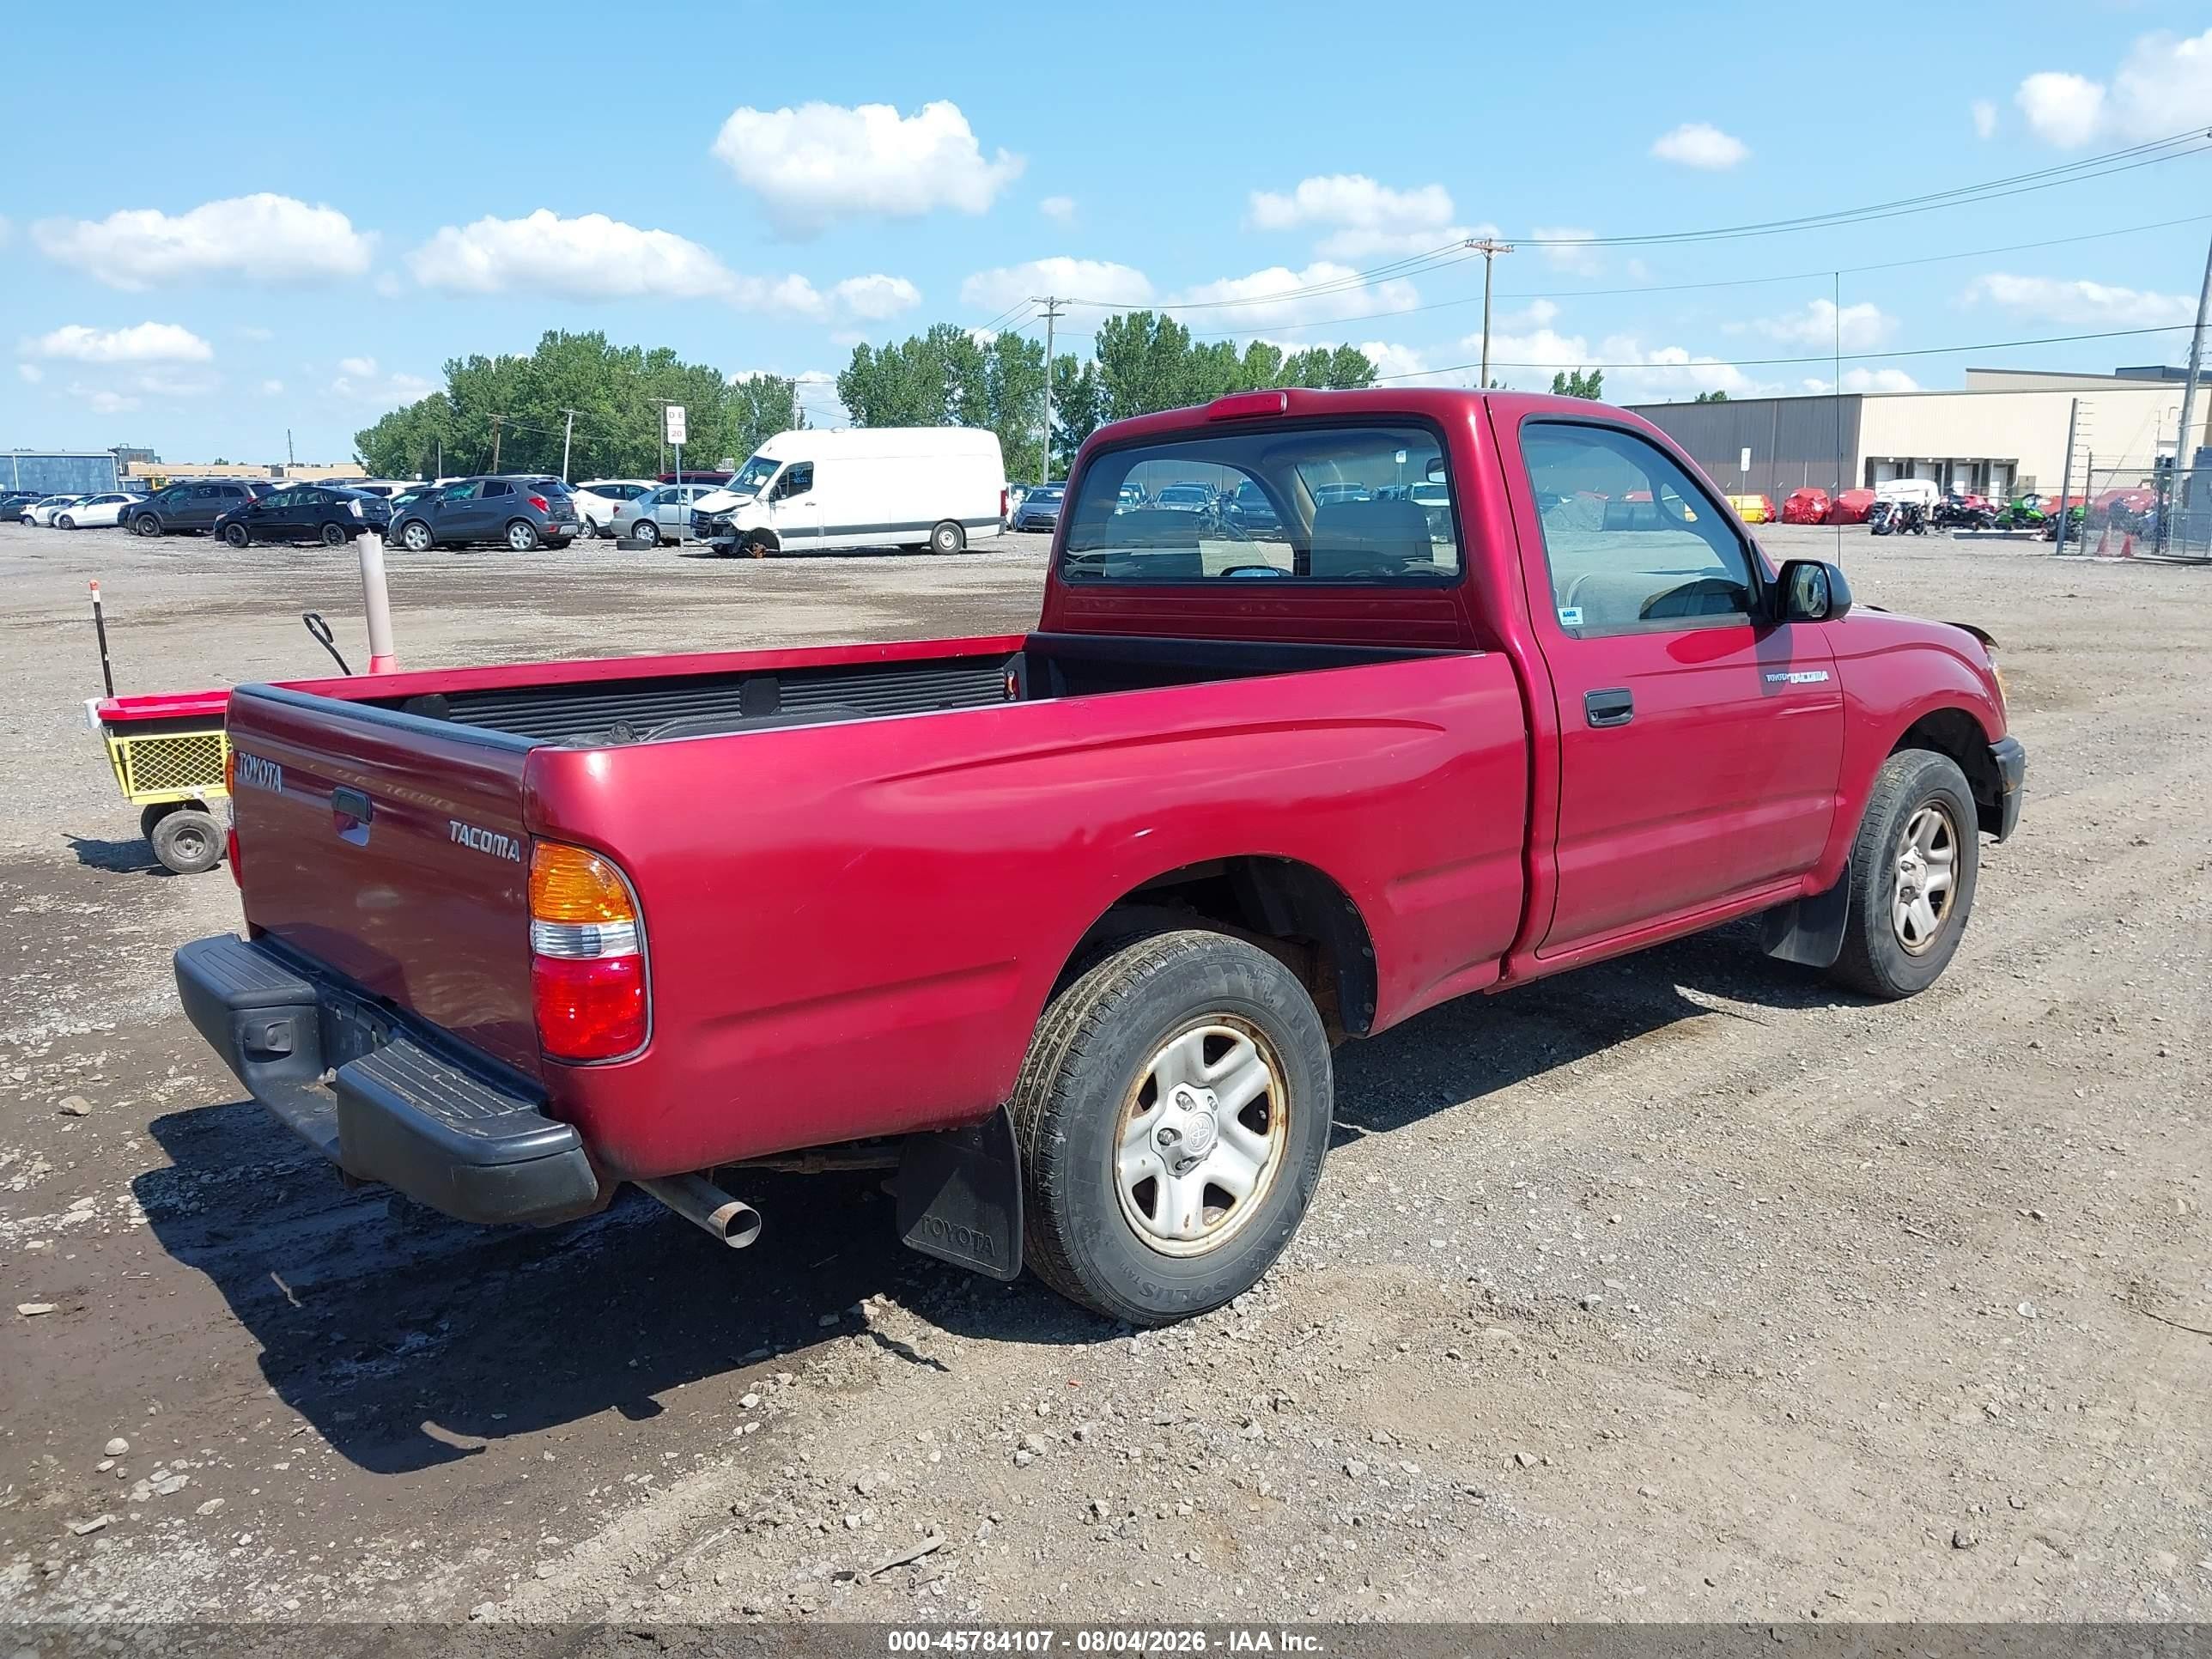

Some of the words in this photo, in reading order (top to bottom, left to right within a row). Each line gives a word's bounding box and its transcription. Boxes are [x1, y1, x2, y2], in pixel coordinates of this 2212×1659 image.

[1789, 671, 1829, 684] TACOMA
[239, 751, 282, 793] TOYOTA
[449, 819, 520, 863] TACOMA
[921, 1214, 995, 1257] TOYOTA
[1139, 1277, 1231, 1304] SOLUS
